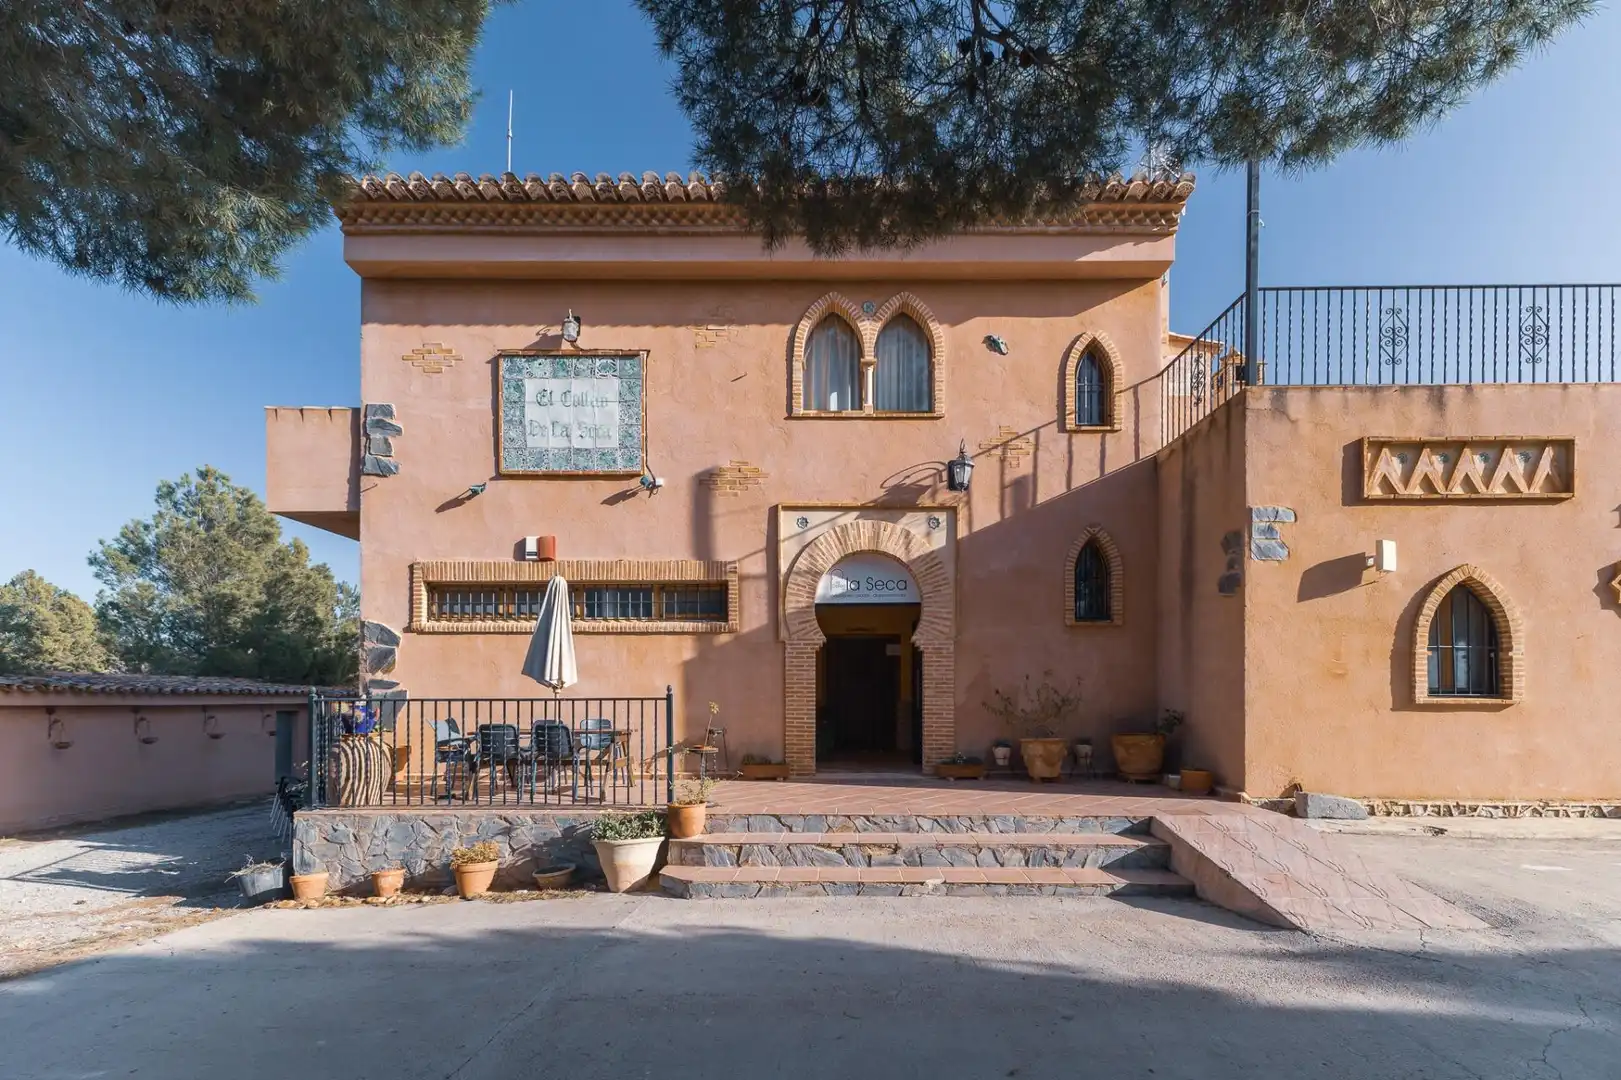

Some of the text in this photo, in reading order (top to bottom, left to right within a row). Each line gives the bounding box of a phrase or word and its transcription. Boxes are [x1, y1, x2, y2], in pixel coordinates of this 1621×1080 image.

[536, 388, 554, 407] El
[551, 420, 571, 438] La
[866, 576, 907, 591] Seca
